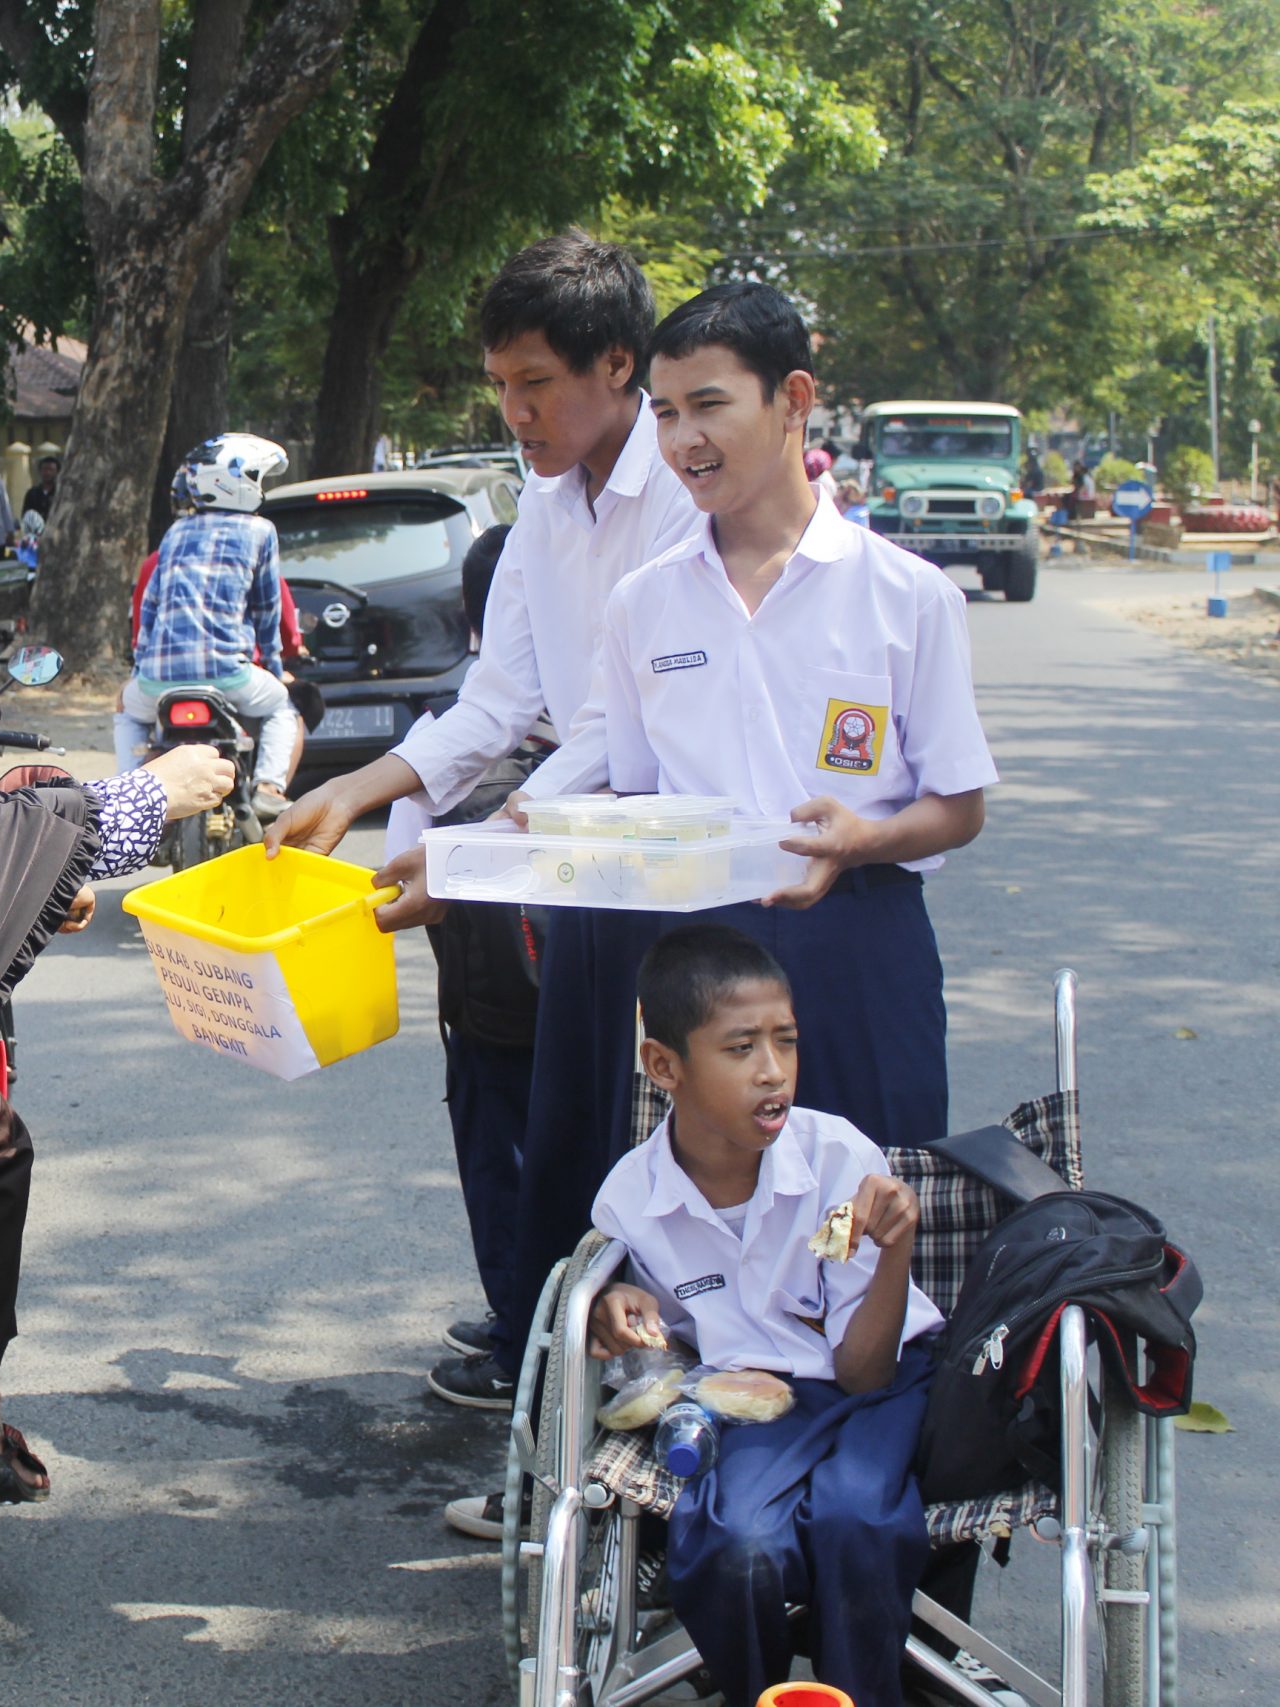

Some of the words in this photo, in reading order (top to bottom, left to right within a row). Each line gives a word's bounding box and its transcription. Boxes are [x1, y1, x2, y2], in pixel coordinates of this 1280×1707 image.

[835, 757, 862, 767] OSIS
[166, 947, 193, 973] KAB.
[194, 960, 254, 989] SUBANG
[160, 966, 201, 997] PEDULI
[202, 985, 253, 1014] GEMPA
[192, 1023, 248, 1057] BANGKIT
[211, 1009, 282, 1039] DONGGALA
